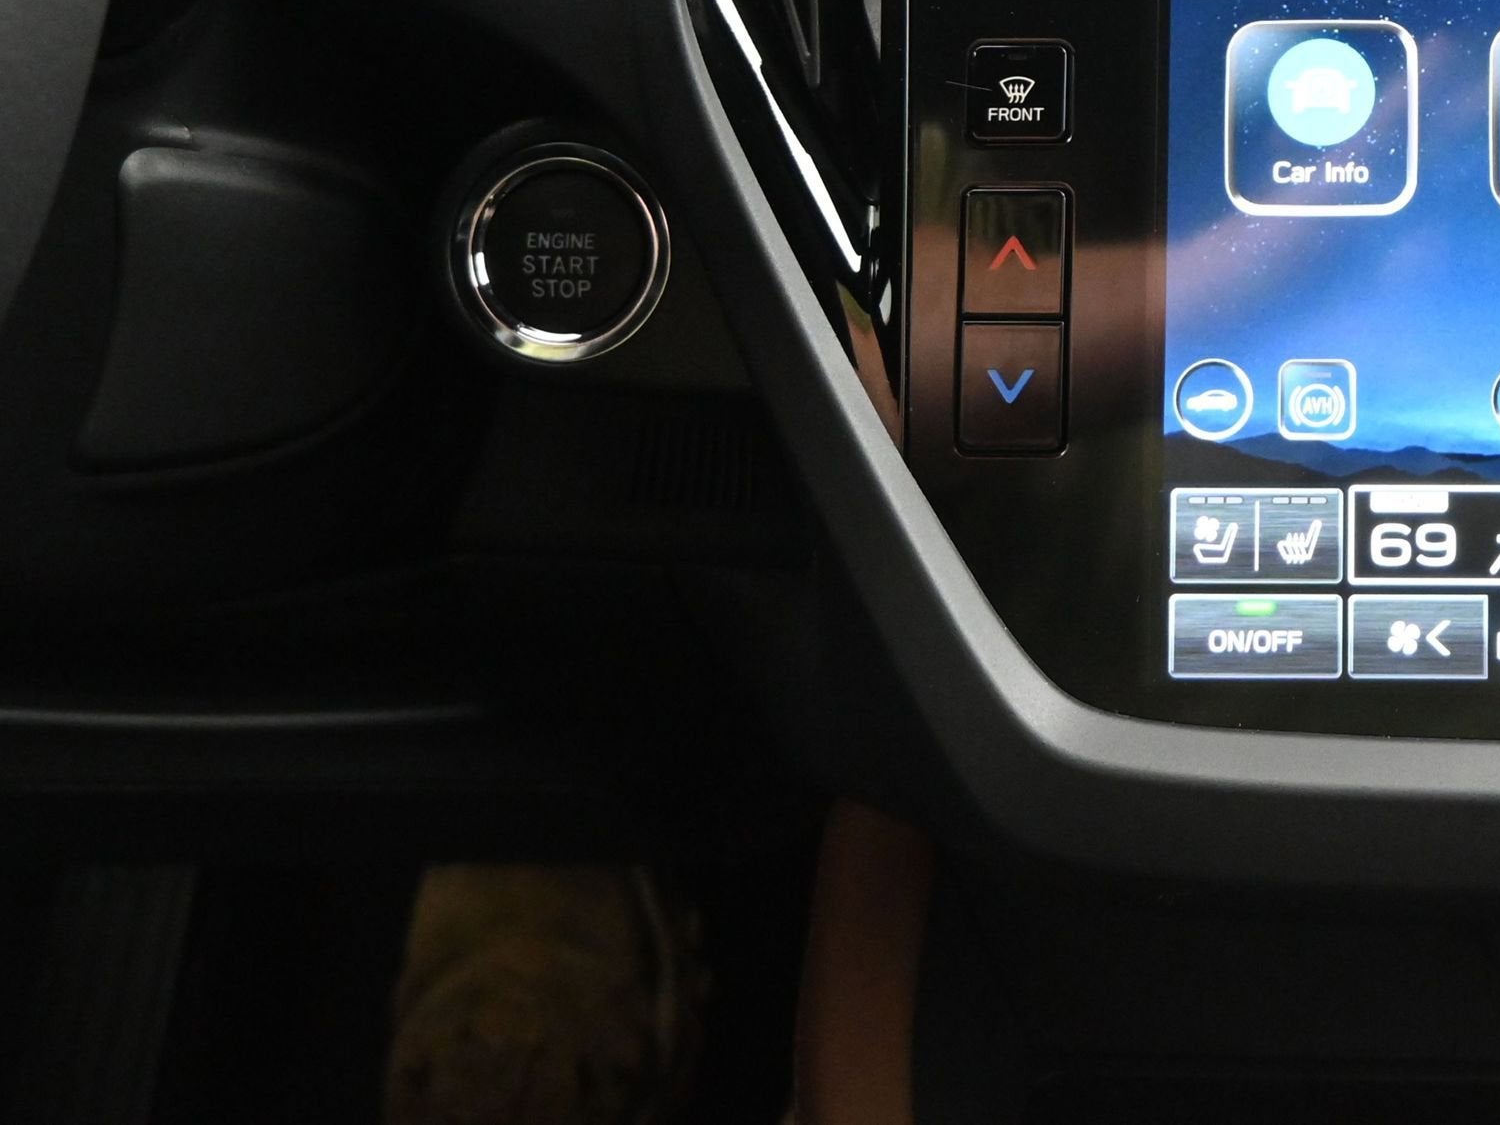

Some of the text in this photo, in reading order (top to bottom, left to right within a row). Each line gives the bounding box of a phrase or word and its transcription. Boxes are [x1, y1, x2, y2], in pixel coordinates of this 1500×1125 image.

[988, 107, 1045, 121] FRONT
[1272, 161, 1370, 185] Car Info
[527, 232, 596, 249] ENGINE
[522, 255, 599, 275] START
[532, 279, 591, 298] STOP
[1302, 395, 1335, 416] AVH
[1369, 524, 1457, 568] 69
[1207, 630, 1304, 655] ON/OFF
